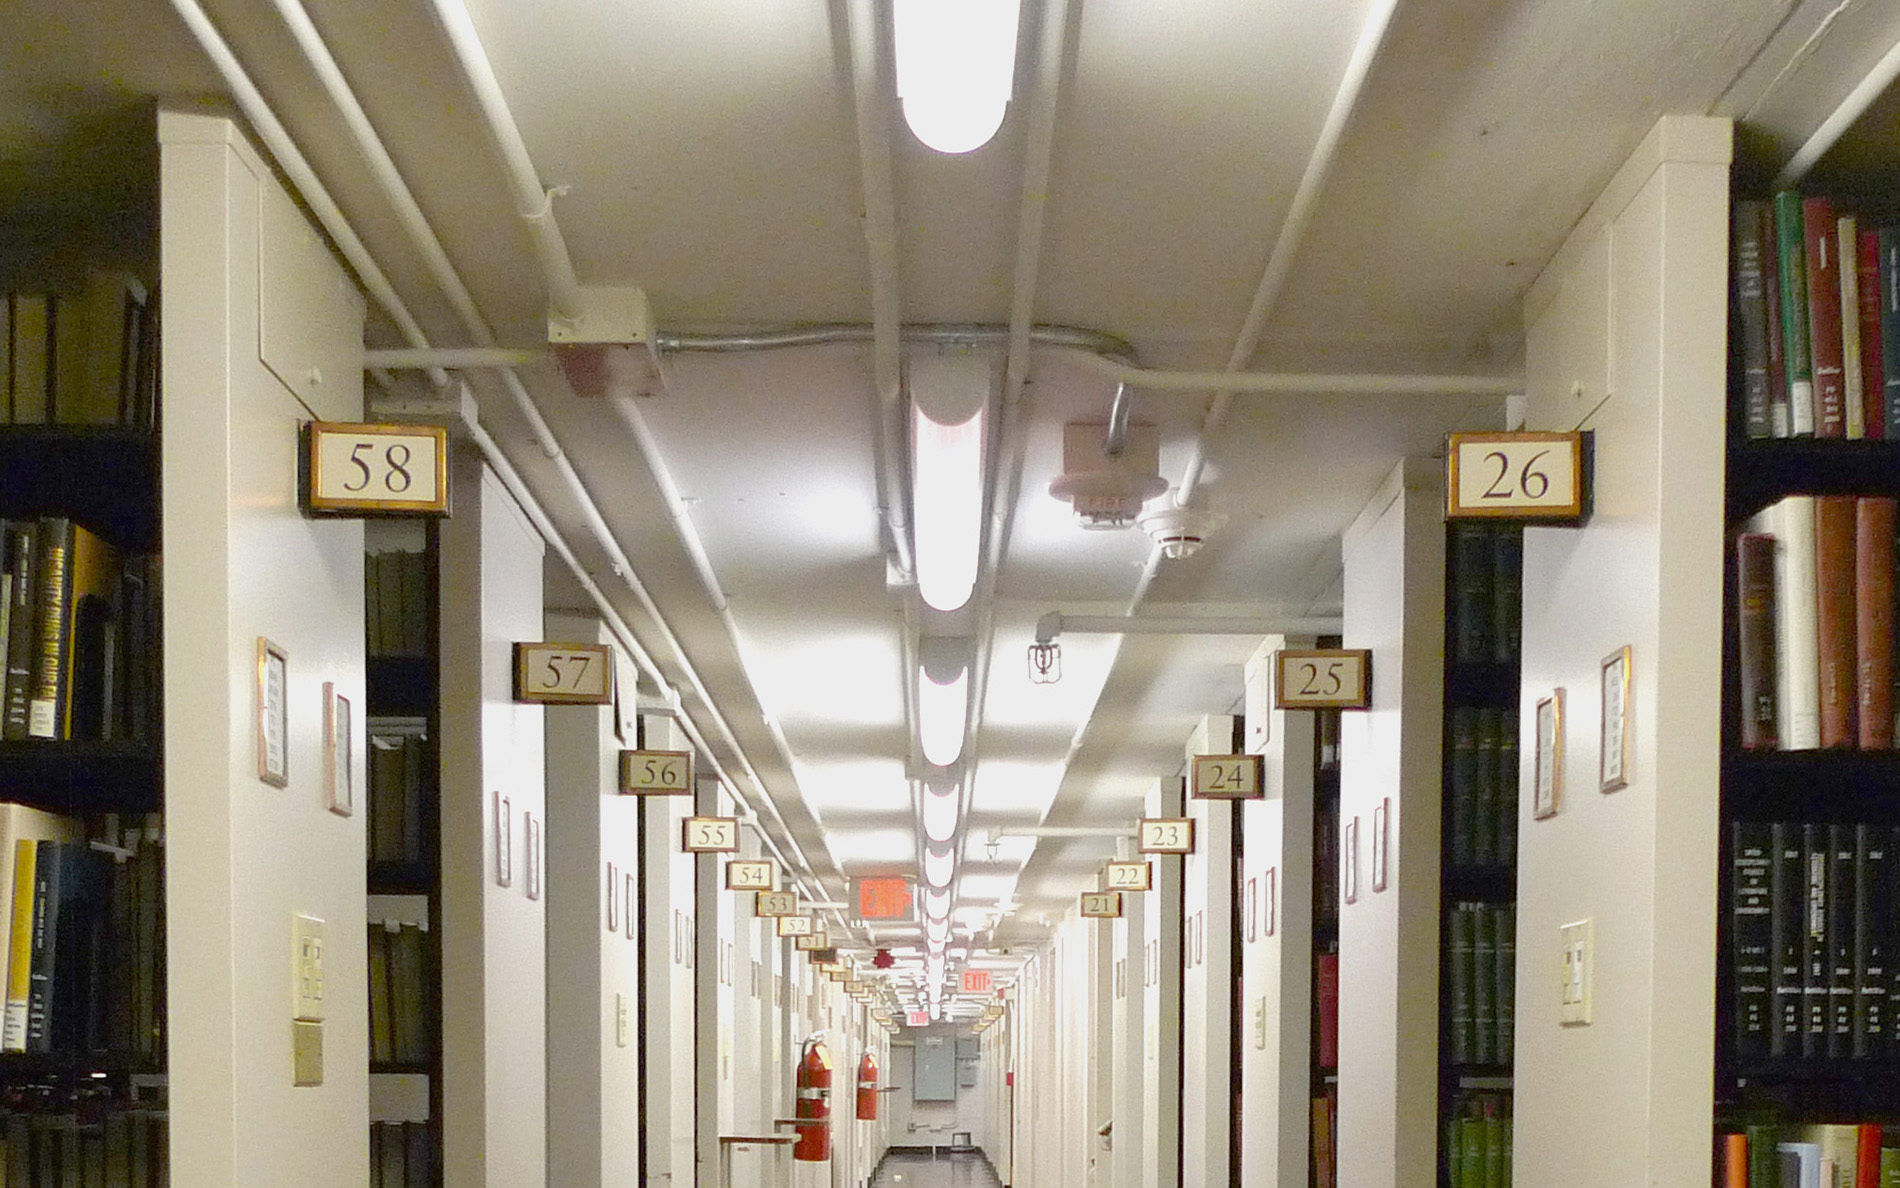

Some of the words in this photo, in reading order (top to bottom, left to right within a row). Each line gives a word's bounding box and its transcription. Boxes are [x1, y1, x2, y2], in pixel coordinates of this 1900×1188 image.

[343, 443, 412, 492] 58
[1481, 450, 1551, 499] 26
[542, 655, 591, 690] 57
[1299, 662, 1344, 695] 25
[641, 759, 677, 785] 56
[1209, 764, 1244, 789] 24
[698, 825, 726, 845] 55
[1152, 826, 1179, 846] 23
[739, 867, 763, 884] 54
[1117, 867, 1139, 885] 22
[768, 896, 788, 912] 53
[1090, 897, 1109, 912] 21
[788, 919, 806, 933] 52
[804, 936, 819, 947] 51
[964, 972, 988, 991] EXIT
